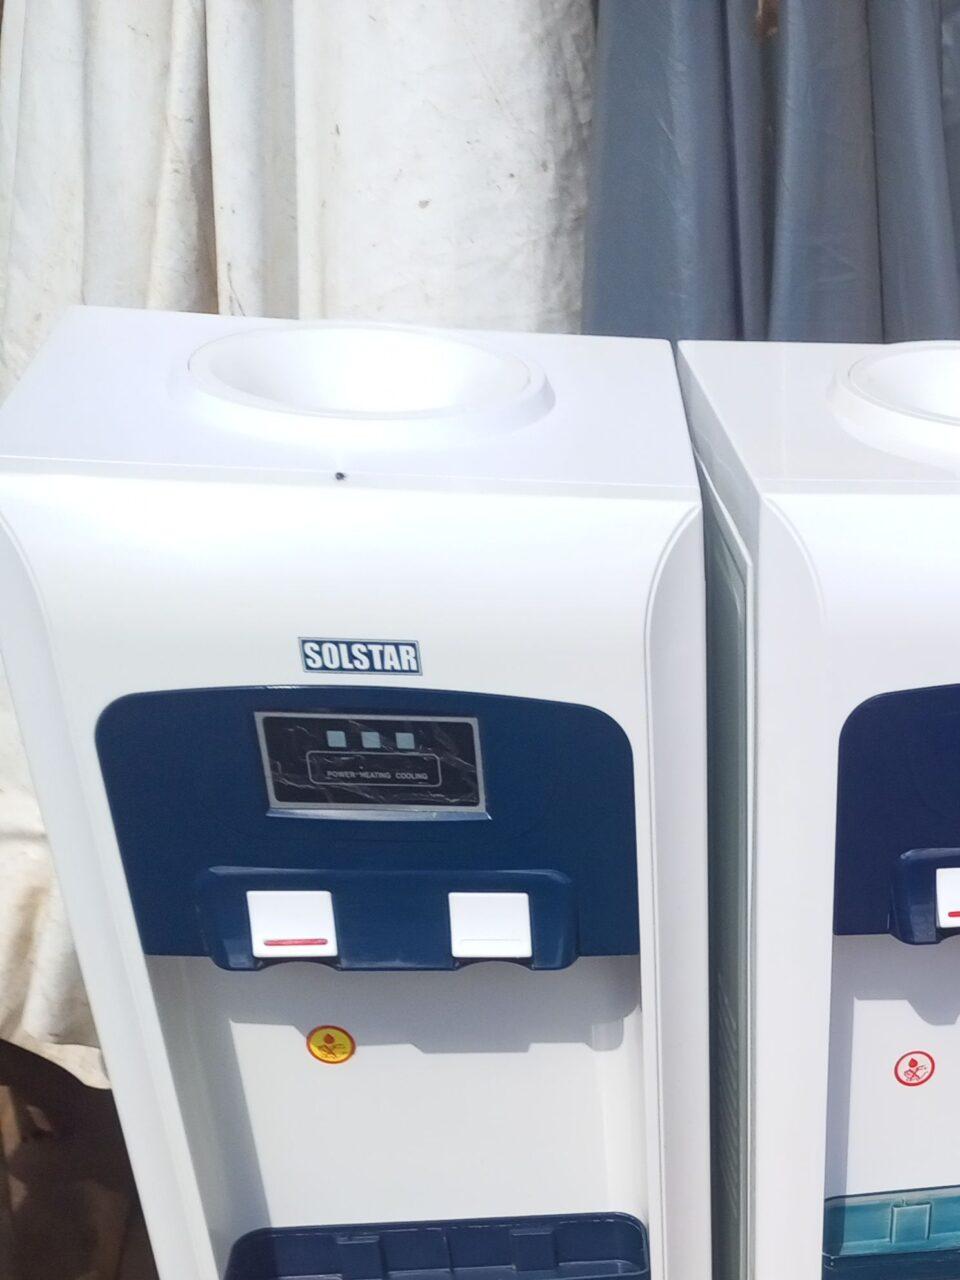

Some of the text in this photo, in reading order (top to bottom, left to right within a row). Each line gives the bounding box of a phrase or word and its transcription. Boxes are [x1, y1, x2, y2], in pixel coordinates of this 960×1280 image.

[303, 641, 418, 673] SOLSTAR
[326, 770, 428, 780] POWER HEATING COOLING
